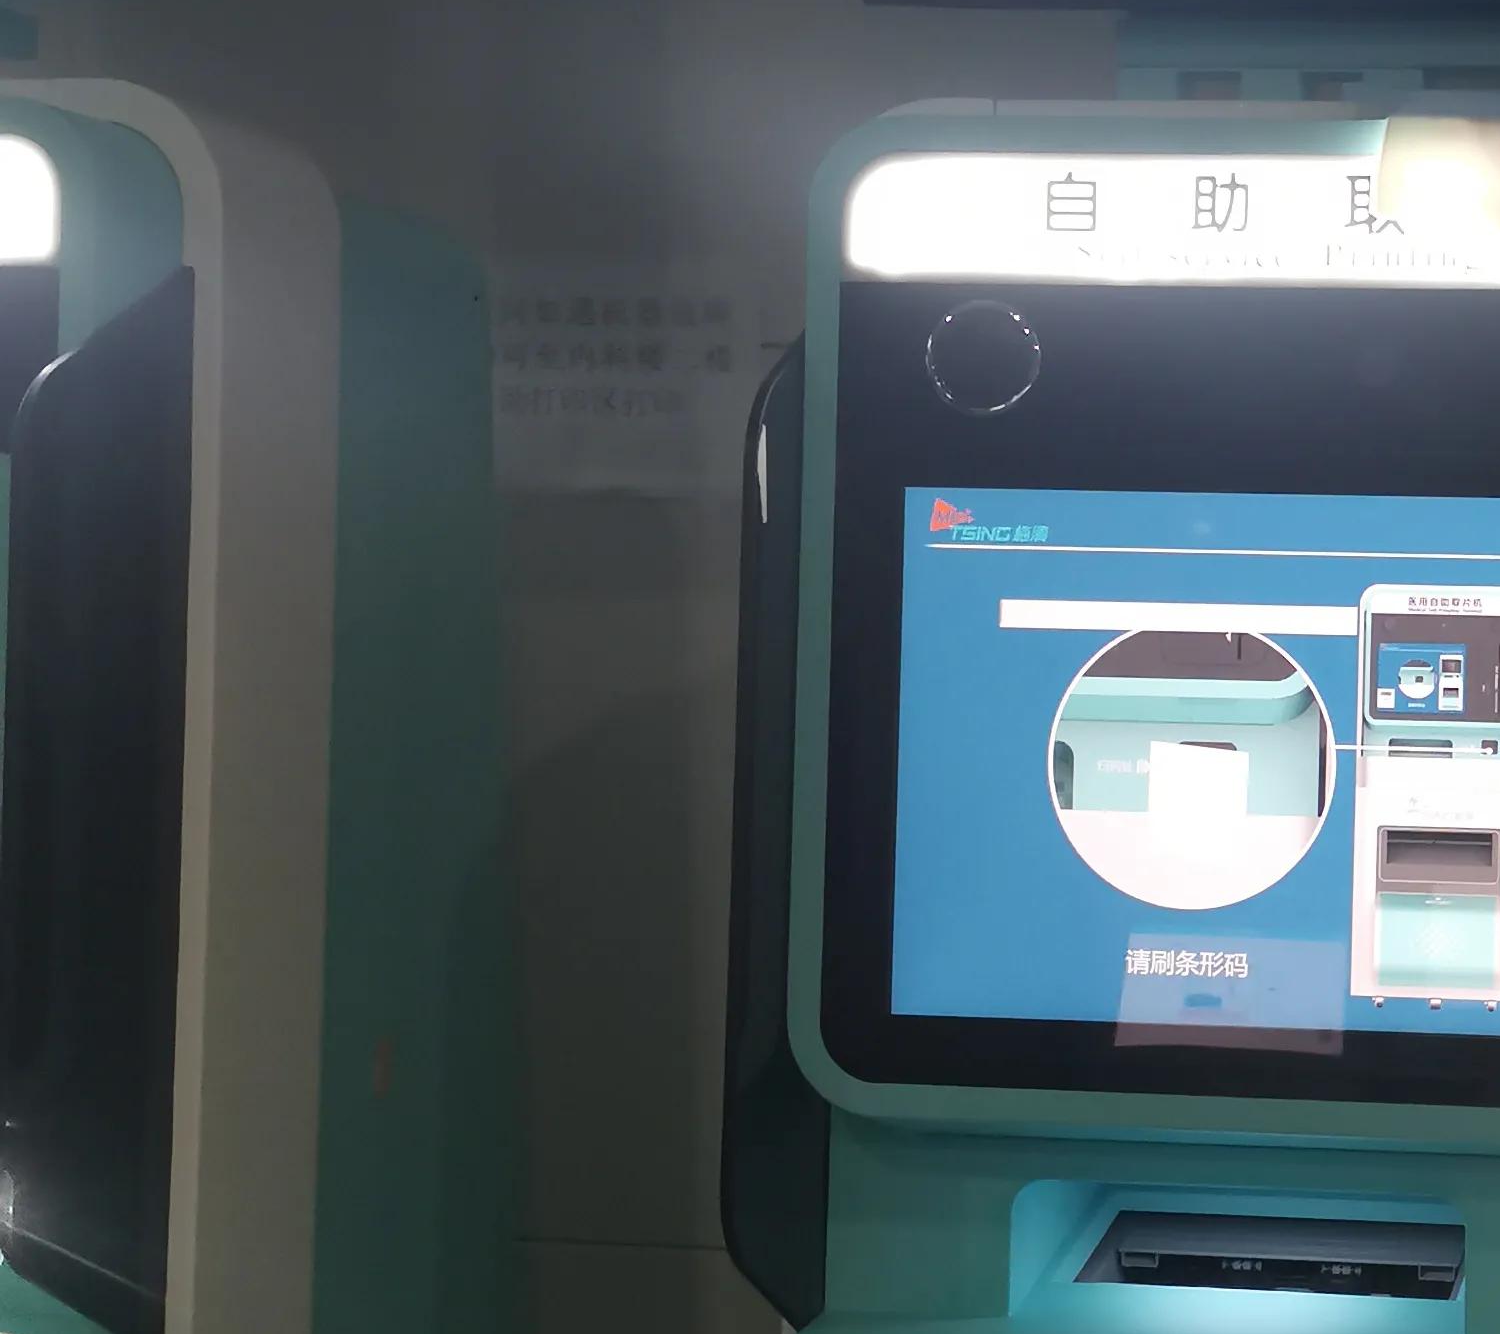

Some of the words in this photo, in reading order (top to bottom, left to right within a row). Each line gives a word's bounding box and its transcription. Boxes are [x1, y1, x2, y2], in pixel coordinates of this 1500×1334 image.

[950, 524, 1013, 543] TSING
[1125, 948, 1249, 979] 请刷条形码
